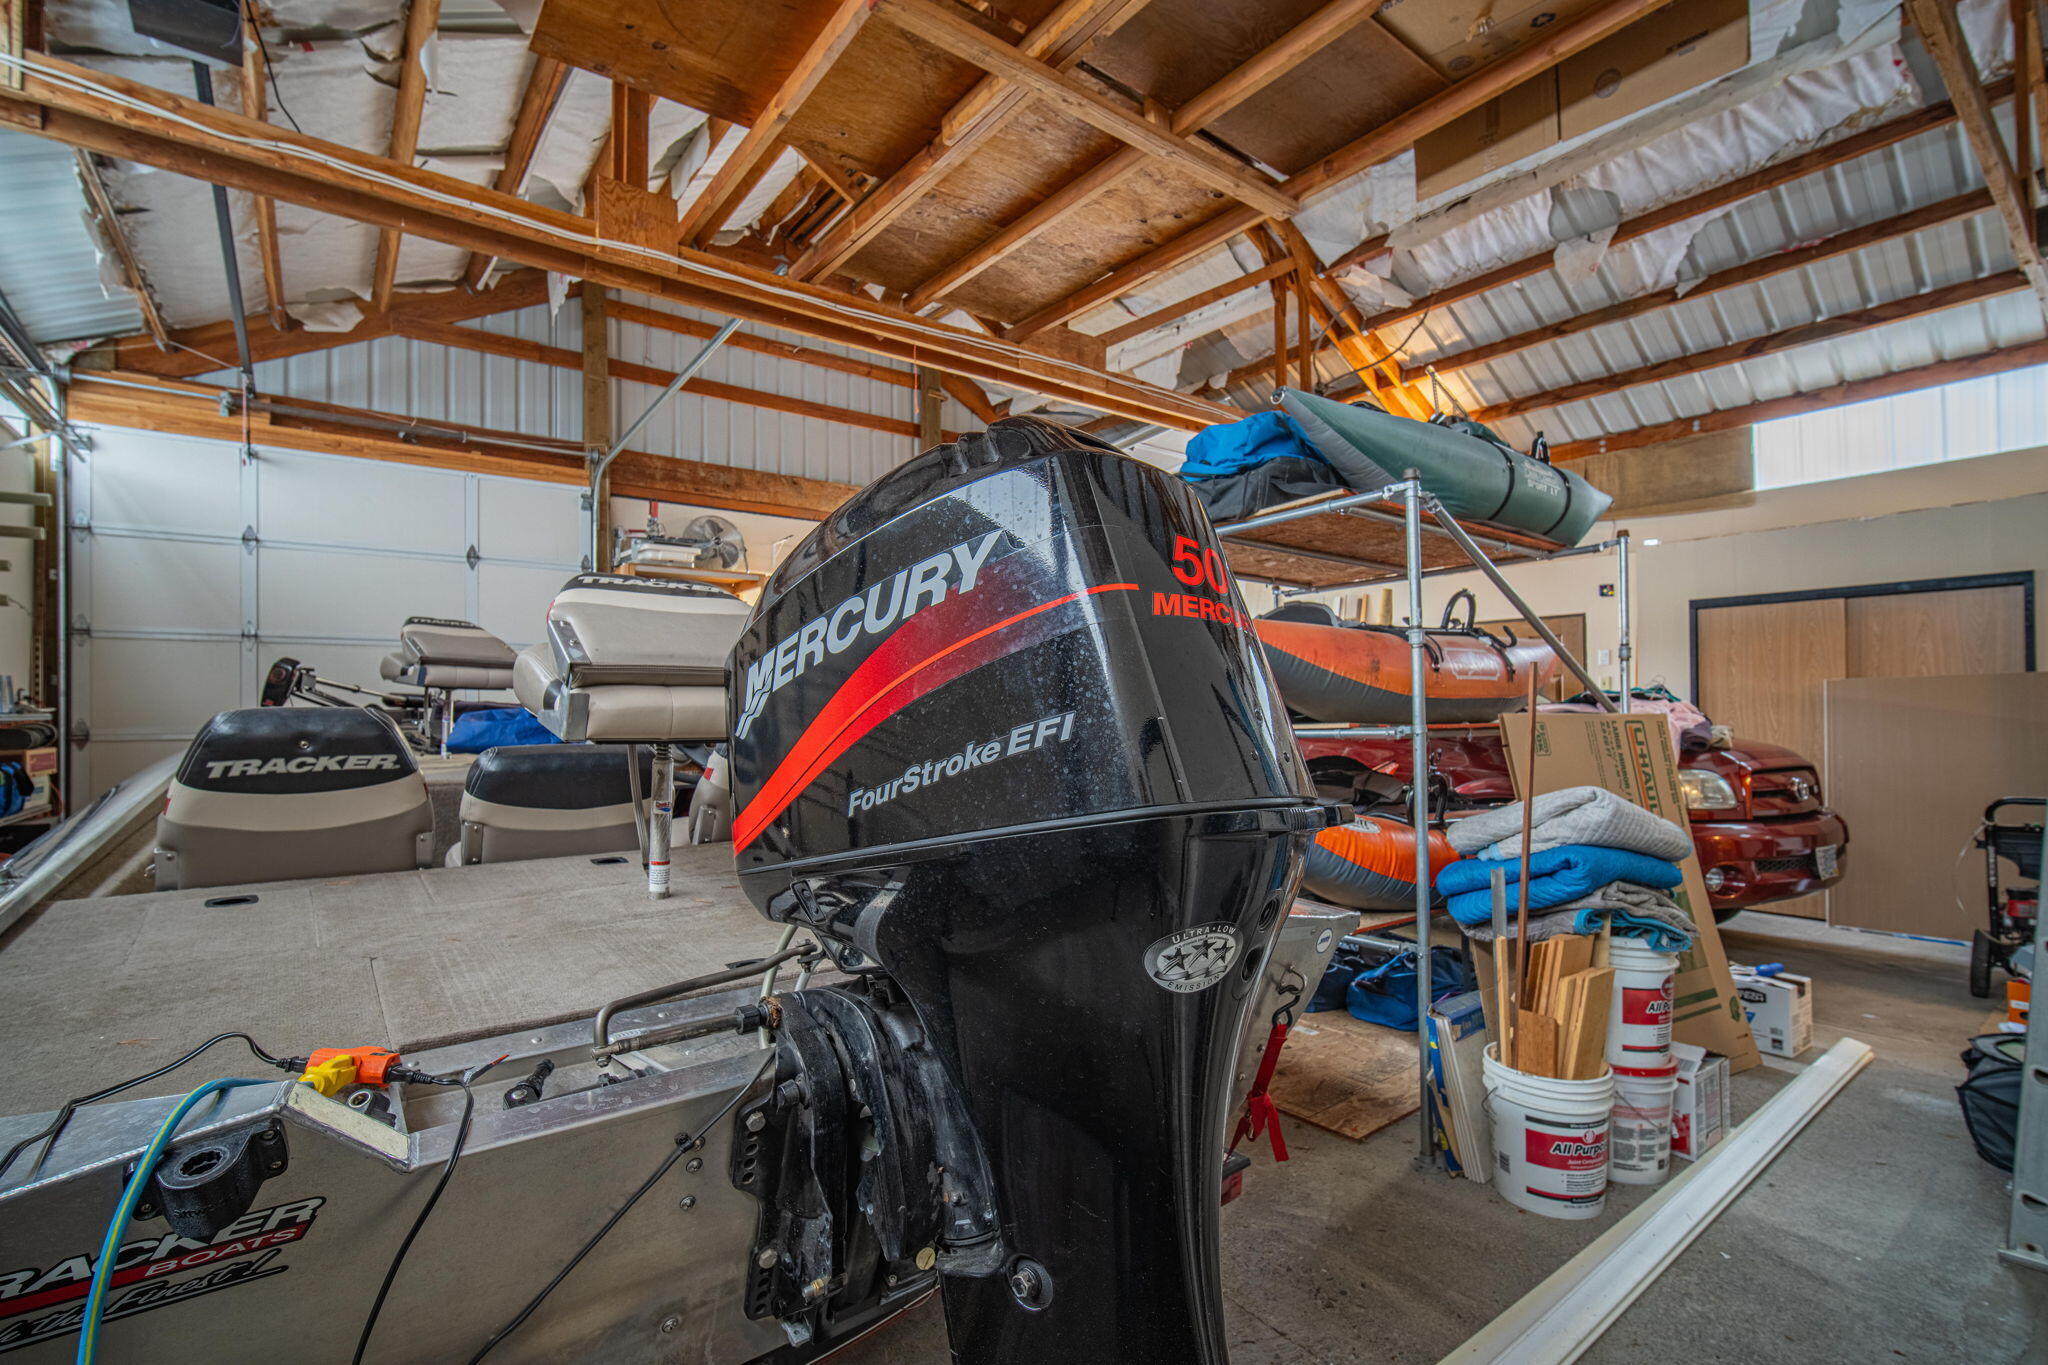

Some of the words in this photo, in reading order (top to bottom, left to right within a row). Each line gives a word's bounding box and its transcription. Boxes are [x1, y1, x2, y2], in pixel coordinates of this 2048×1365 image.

[578, 576, 724, 594] TRACKER
[1172, 535, 1229, 595] 50
[735, 529, 1003, 740] MERCURY
[206, 754, 400, 779] TRACKER
[848, 737, 1000, 818] FourStroke
[1006, 711, 1077, 757] EFI
[1167, 975, 1221, 991] EMISSION
[1551, 1142, 1572, 1155] All
[0, 1199, 324, 1300] RACKER
[145, 1228, 297, 1277] BOATS
